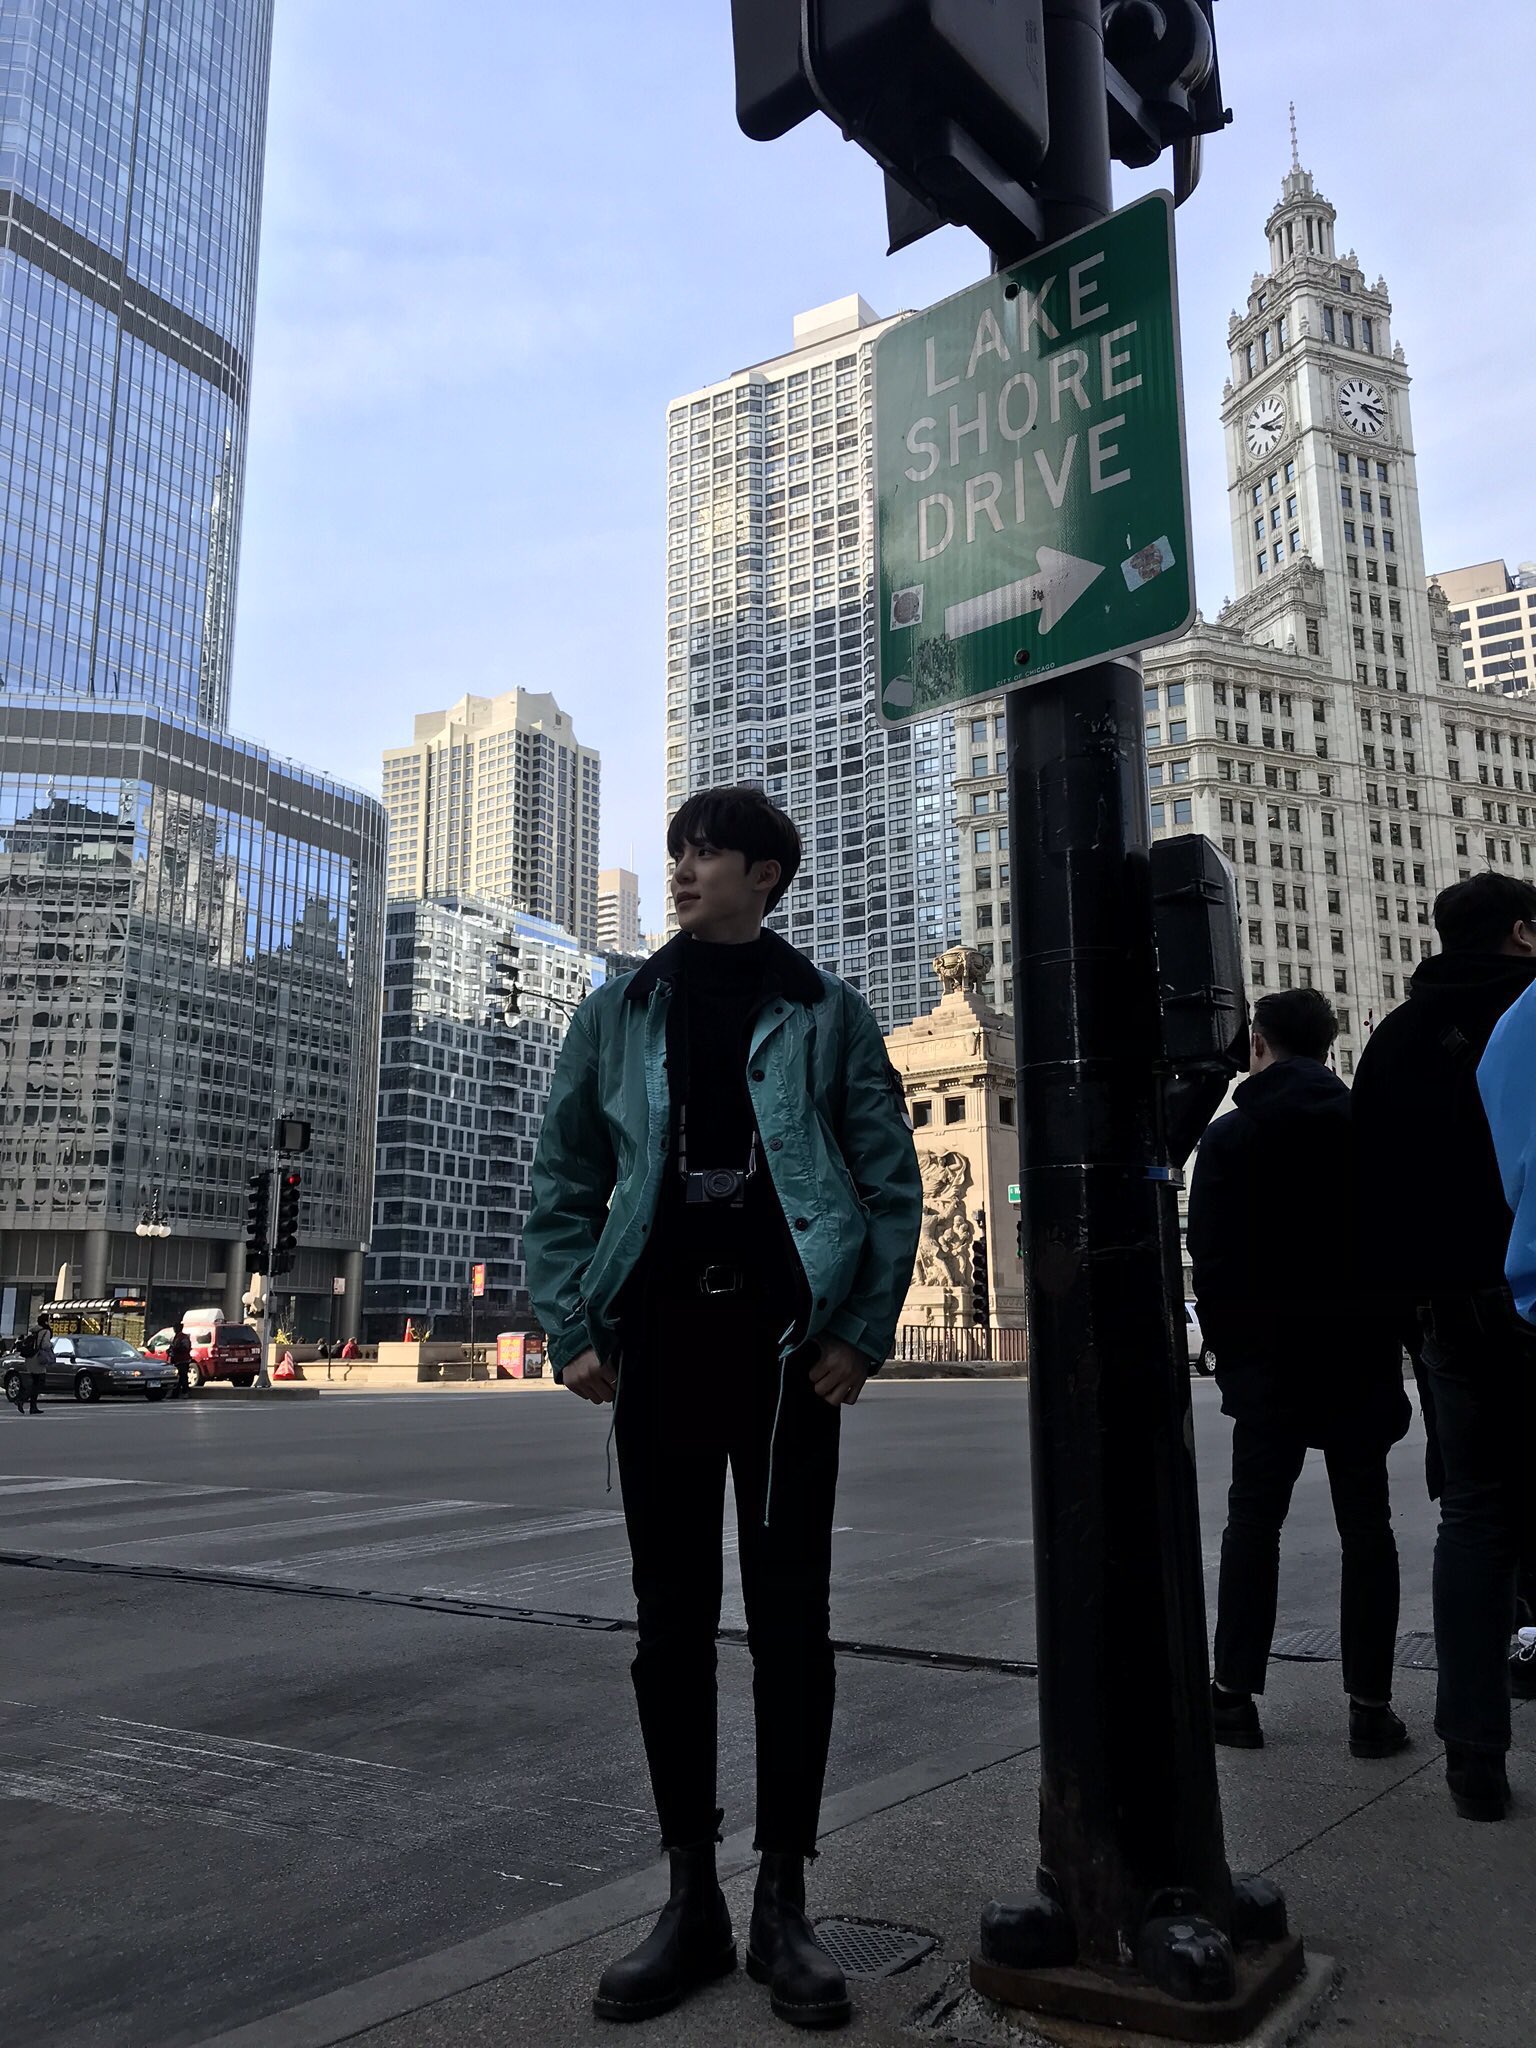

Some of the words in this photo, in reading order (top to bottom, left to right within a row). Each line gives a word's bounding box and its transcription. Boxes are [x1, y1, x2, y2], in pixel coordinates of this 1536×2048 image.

[926, 251, 1109, 397] LAKE
[904, 320, 1143, 482] SHORE
[918, 413, 1131, 562] DRIVE
[996, 677, 1011, 687] CITY
[1013, 673, 1023, 681] OF
[1024, 662, 1056, 677] CHICAGO
